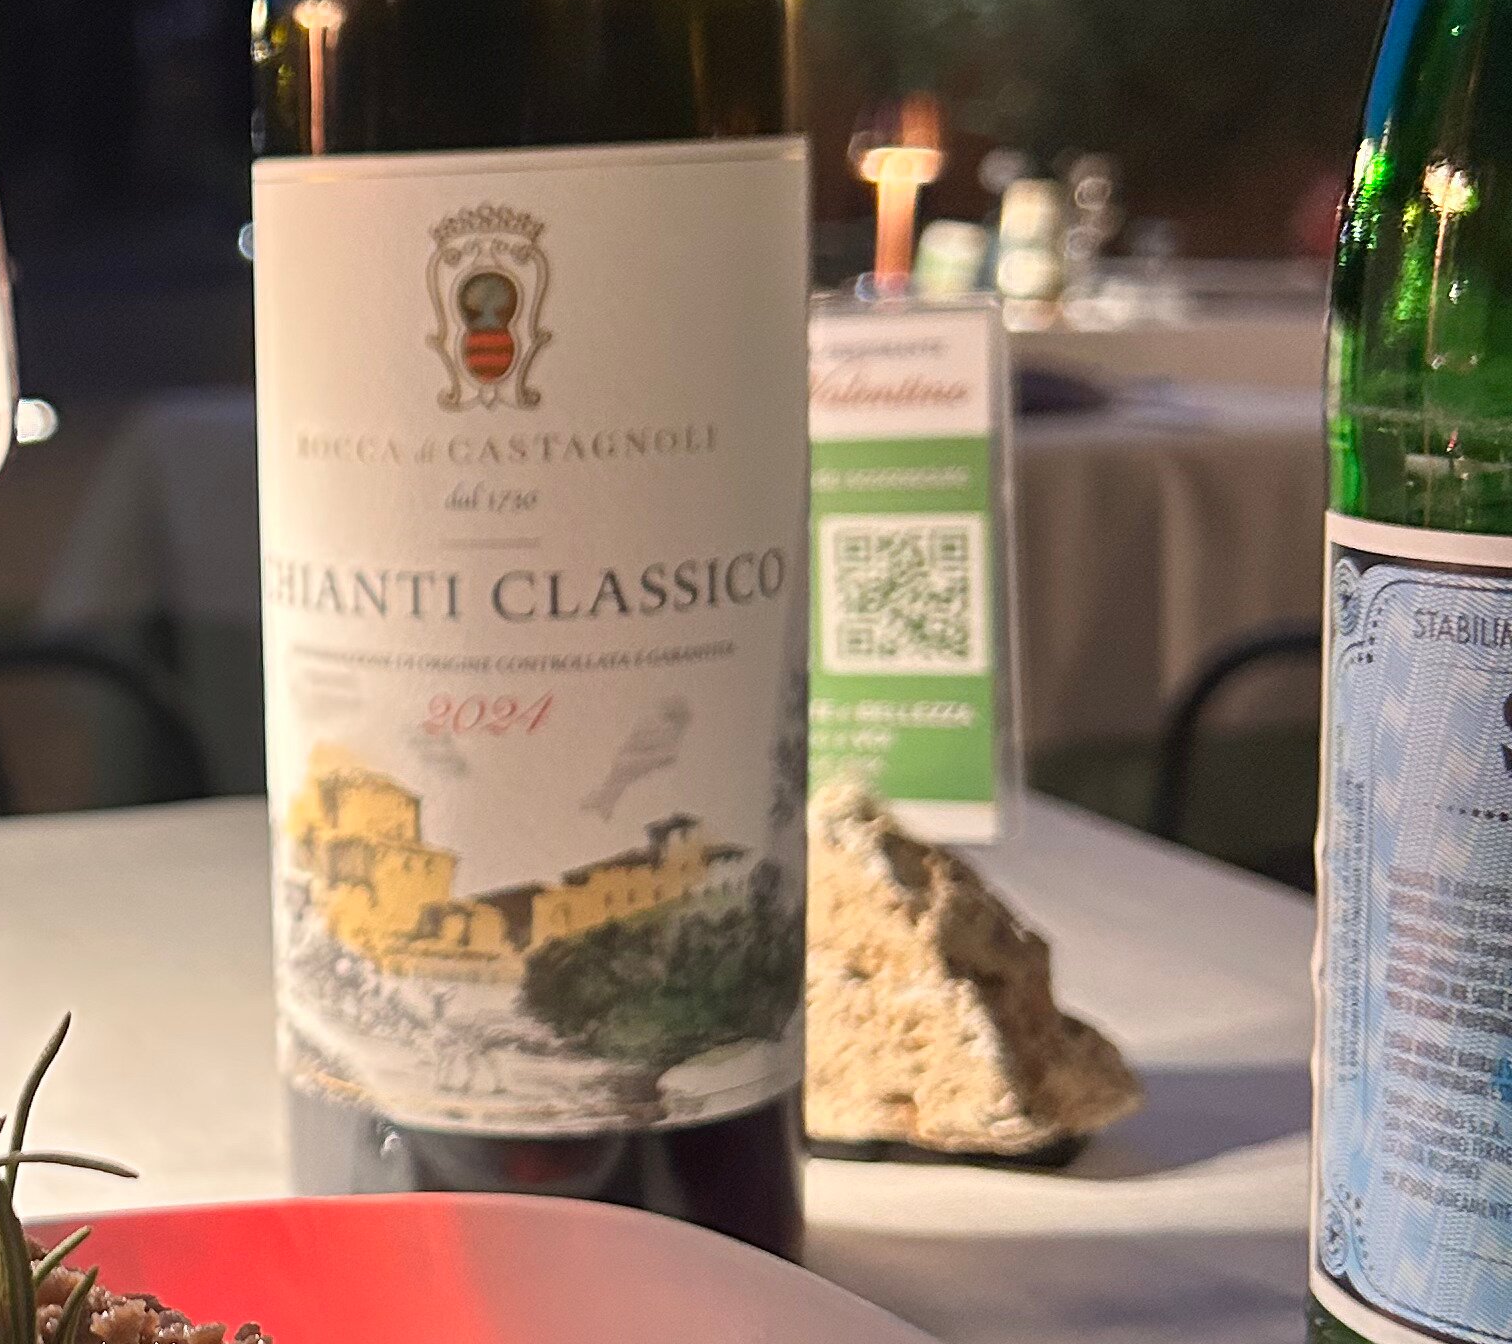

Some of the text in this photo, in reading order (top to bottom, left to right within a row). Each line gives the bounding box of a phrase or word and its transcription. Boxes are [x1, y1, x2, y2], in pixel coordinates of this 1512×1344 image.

[447, 422, 716, 463] CASTAGNOLI
[266, 547, 786, 624] HIANTI CLASSICO
[423, 689, 554, 737] 2024
